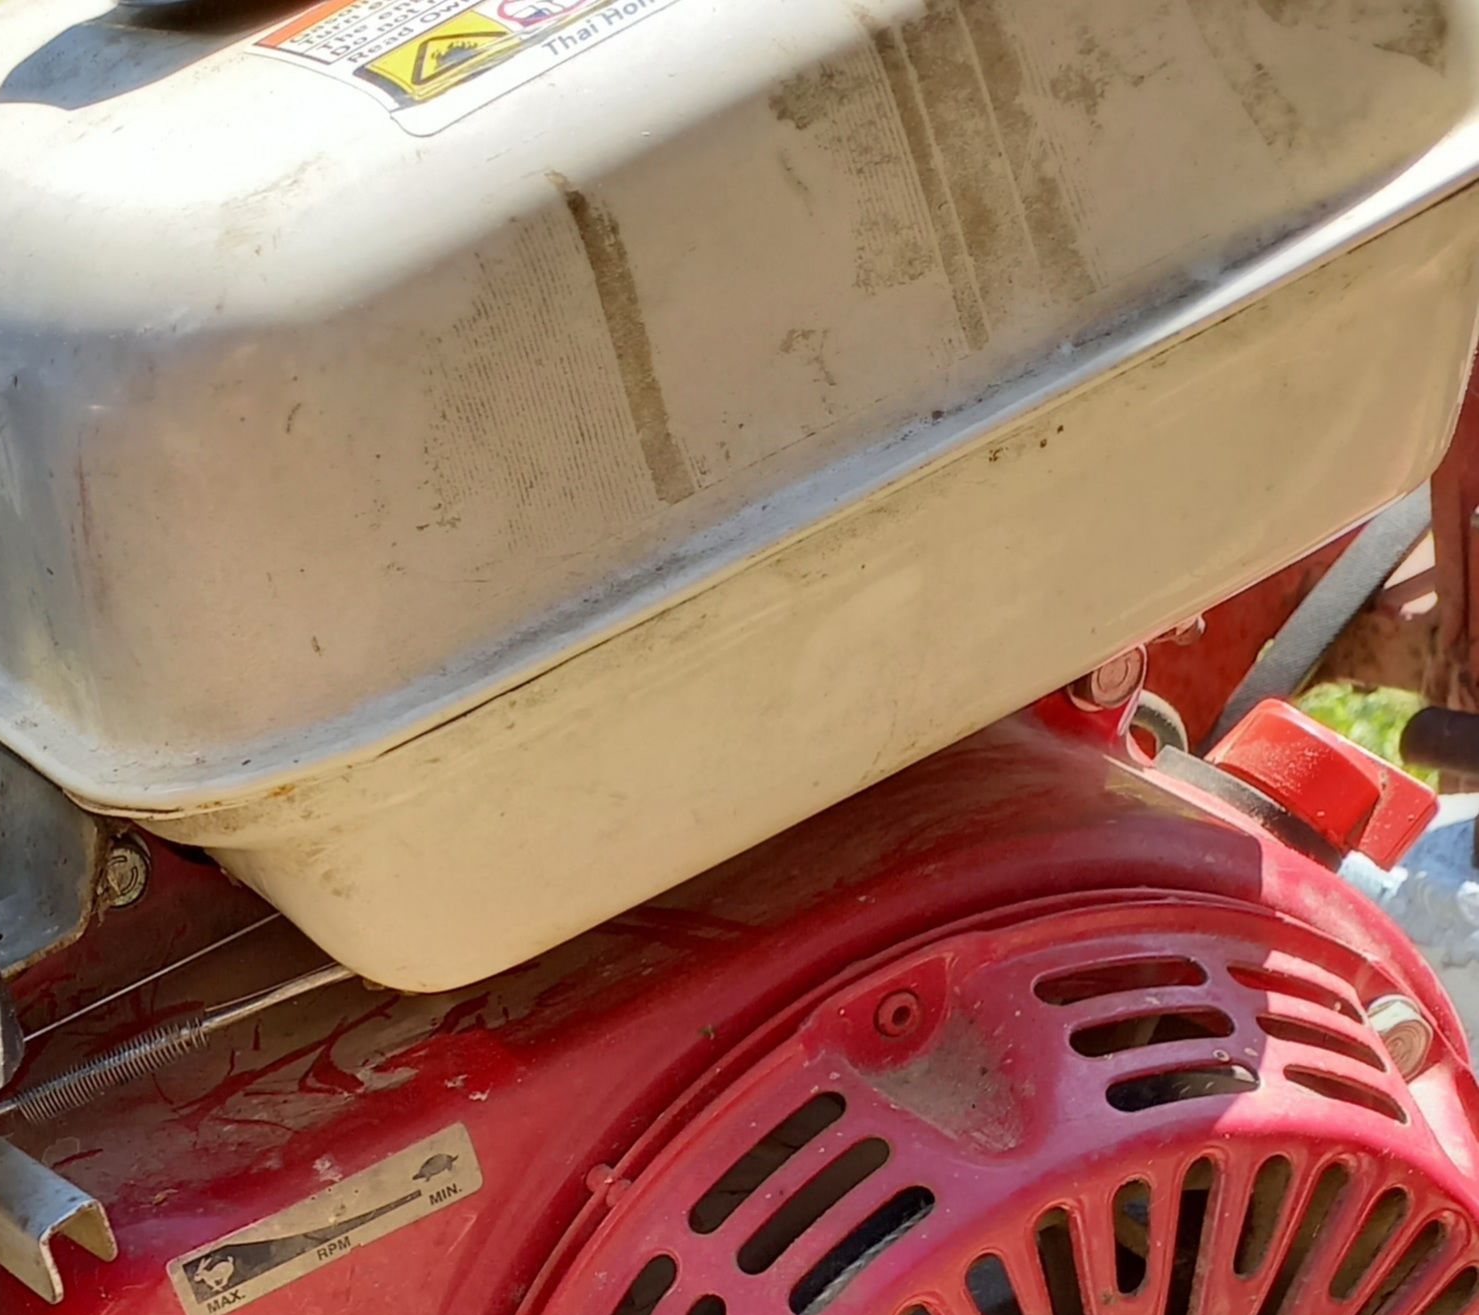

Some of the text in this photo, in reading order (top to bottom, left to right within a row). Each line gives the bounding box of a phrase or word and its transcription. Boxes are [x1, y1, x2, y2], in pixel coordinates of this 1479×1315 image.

[298, 15, 360, 45] Turn
[318, 25, 368, 50] The
[330, 9, 420, 57] Do not
[542, 18, 599, 56] Thai
[348, 26, 414, 63] Read
[428, 1182, 463, 1207] MIN.
[316, 1236, 352, 1261] RPM
[206, 1289, 246, 1314] MAX.
